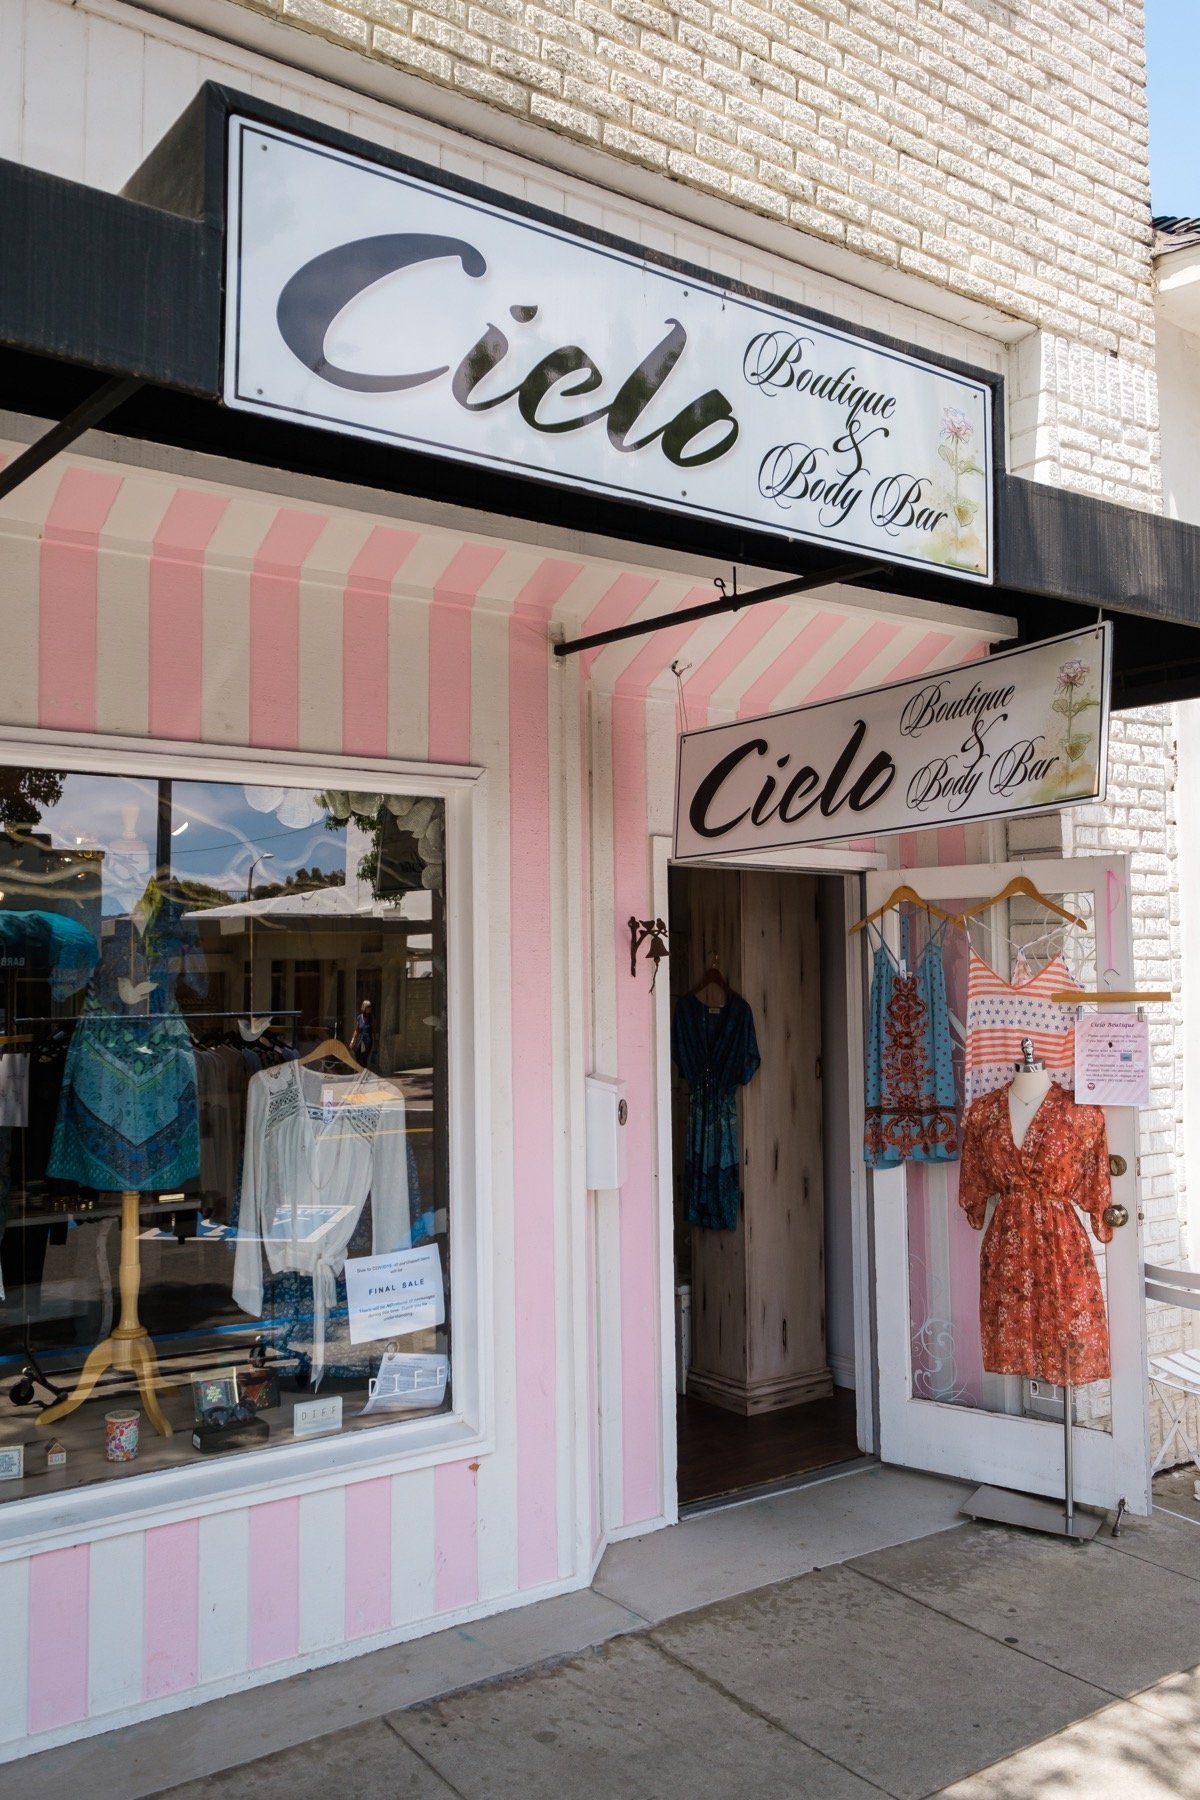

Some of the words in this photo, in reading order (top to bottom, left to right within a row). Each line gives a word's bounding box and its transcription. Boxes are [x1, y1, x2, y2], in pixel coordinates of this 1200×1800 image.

[277, 233, 740, 468] Cielo
[743, 331, 896, 429] Boutique
[833, 420, 889, 476] &
[758, 443, 870, 527] Body
[870, 474, 948, 536] Bar
[900, 680, 1015, 738] Boutique
[961, 714, 1008, 767] &
[689, 719, 896, 838] Cielo
[906, 754, 990, 813] Body
[989, 736, 1059, 797] Bar
[369, 1284, 396, 1295] FINAL
[402, 1278, 425, 1289] SALE
[302, 1405, 337, 1421] DIFF
